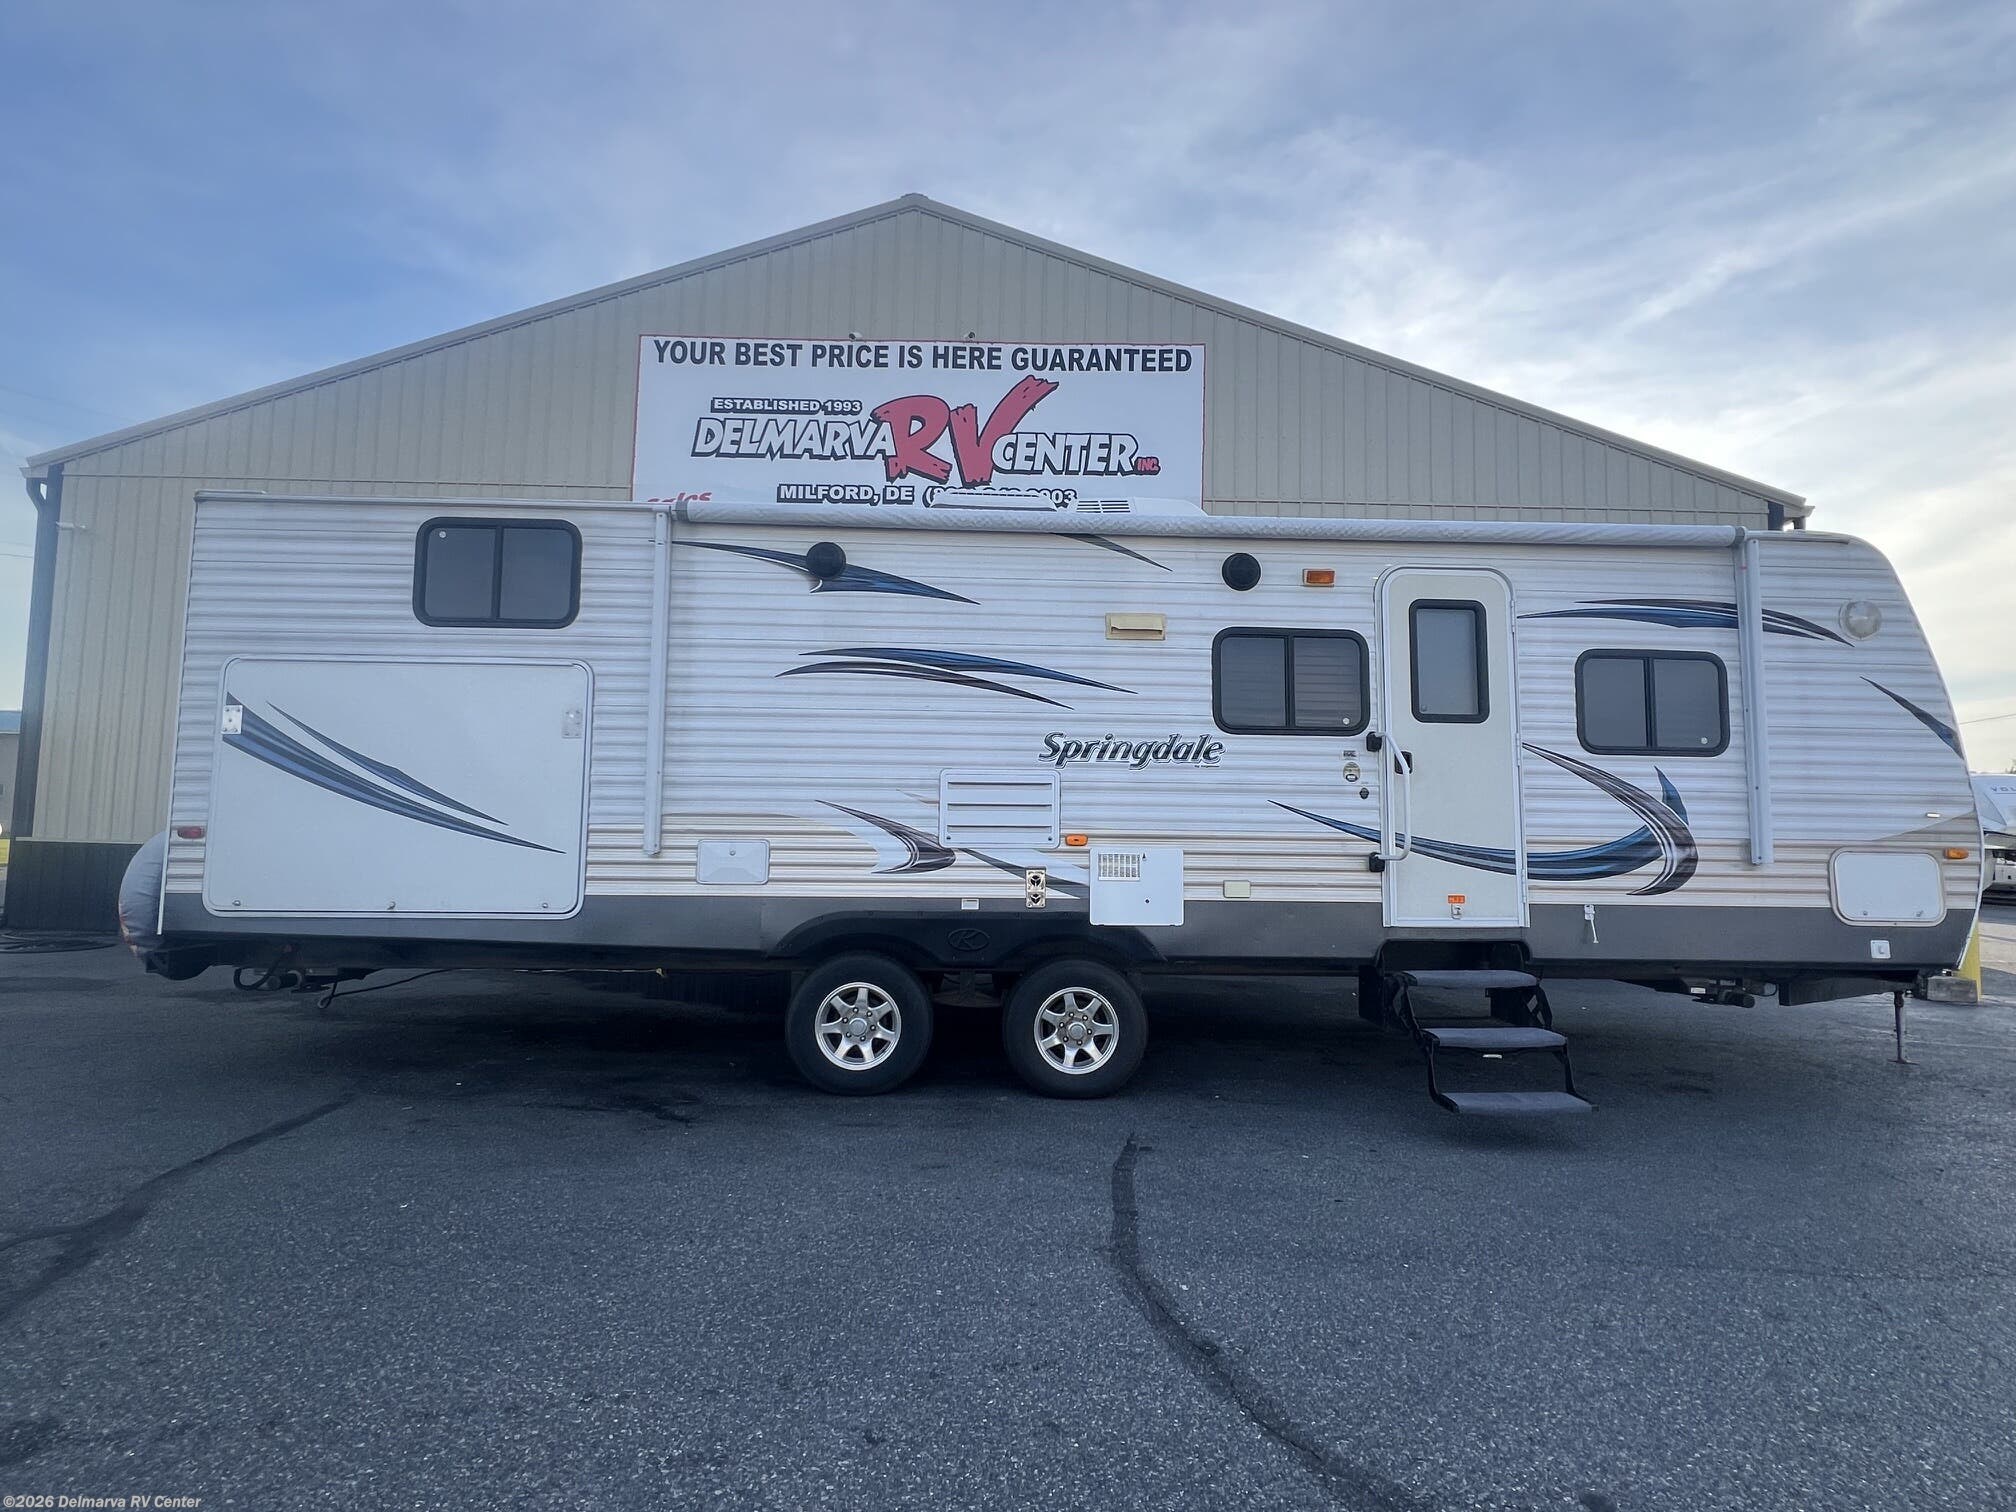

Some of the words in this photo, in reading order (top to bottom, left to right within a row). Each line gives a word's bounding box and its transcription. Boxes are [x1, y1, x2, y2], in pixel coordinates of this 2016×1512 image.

[653, 339, 726, 366] YOUR
[734, 342, 803, 367] BEST
[811, 344, 889, 368] PRICE
[898, 345, 924, 368] IS
[932, 345, 1002, 370] HERE
[1011, 347, 1192, 372] GUARANTEED
[713, 398, 821, 413] ESTABLISHED
[823, 400, 862, 413] 1993
[691, 417, 899, 460] DELMARVA
[870, 374, 1060, 486] RV
[991, 432, 1139, 476] CENTER
[778, 484, 880, 504] MILFORD,
[884, 486, 914, 503] DE
[1038, 731, 1226, 770] Springdale
